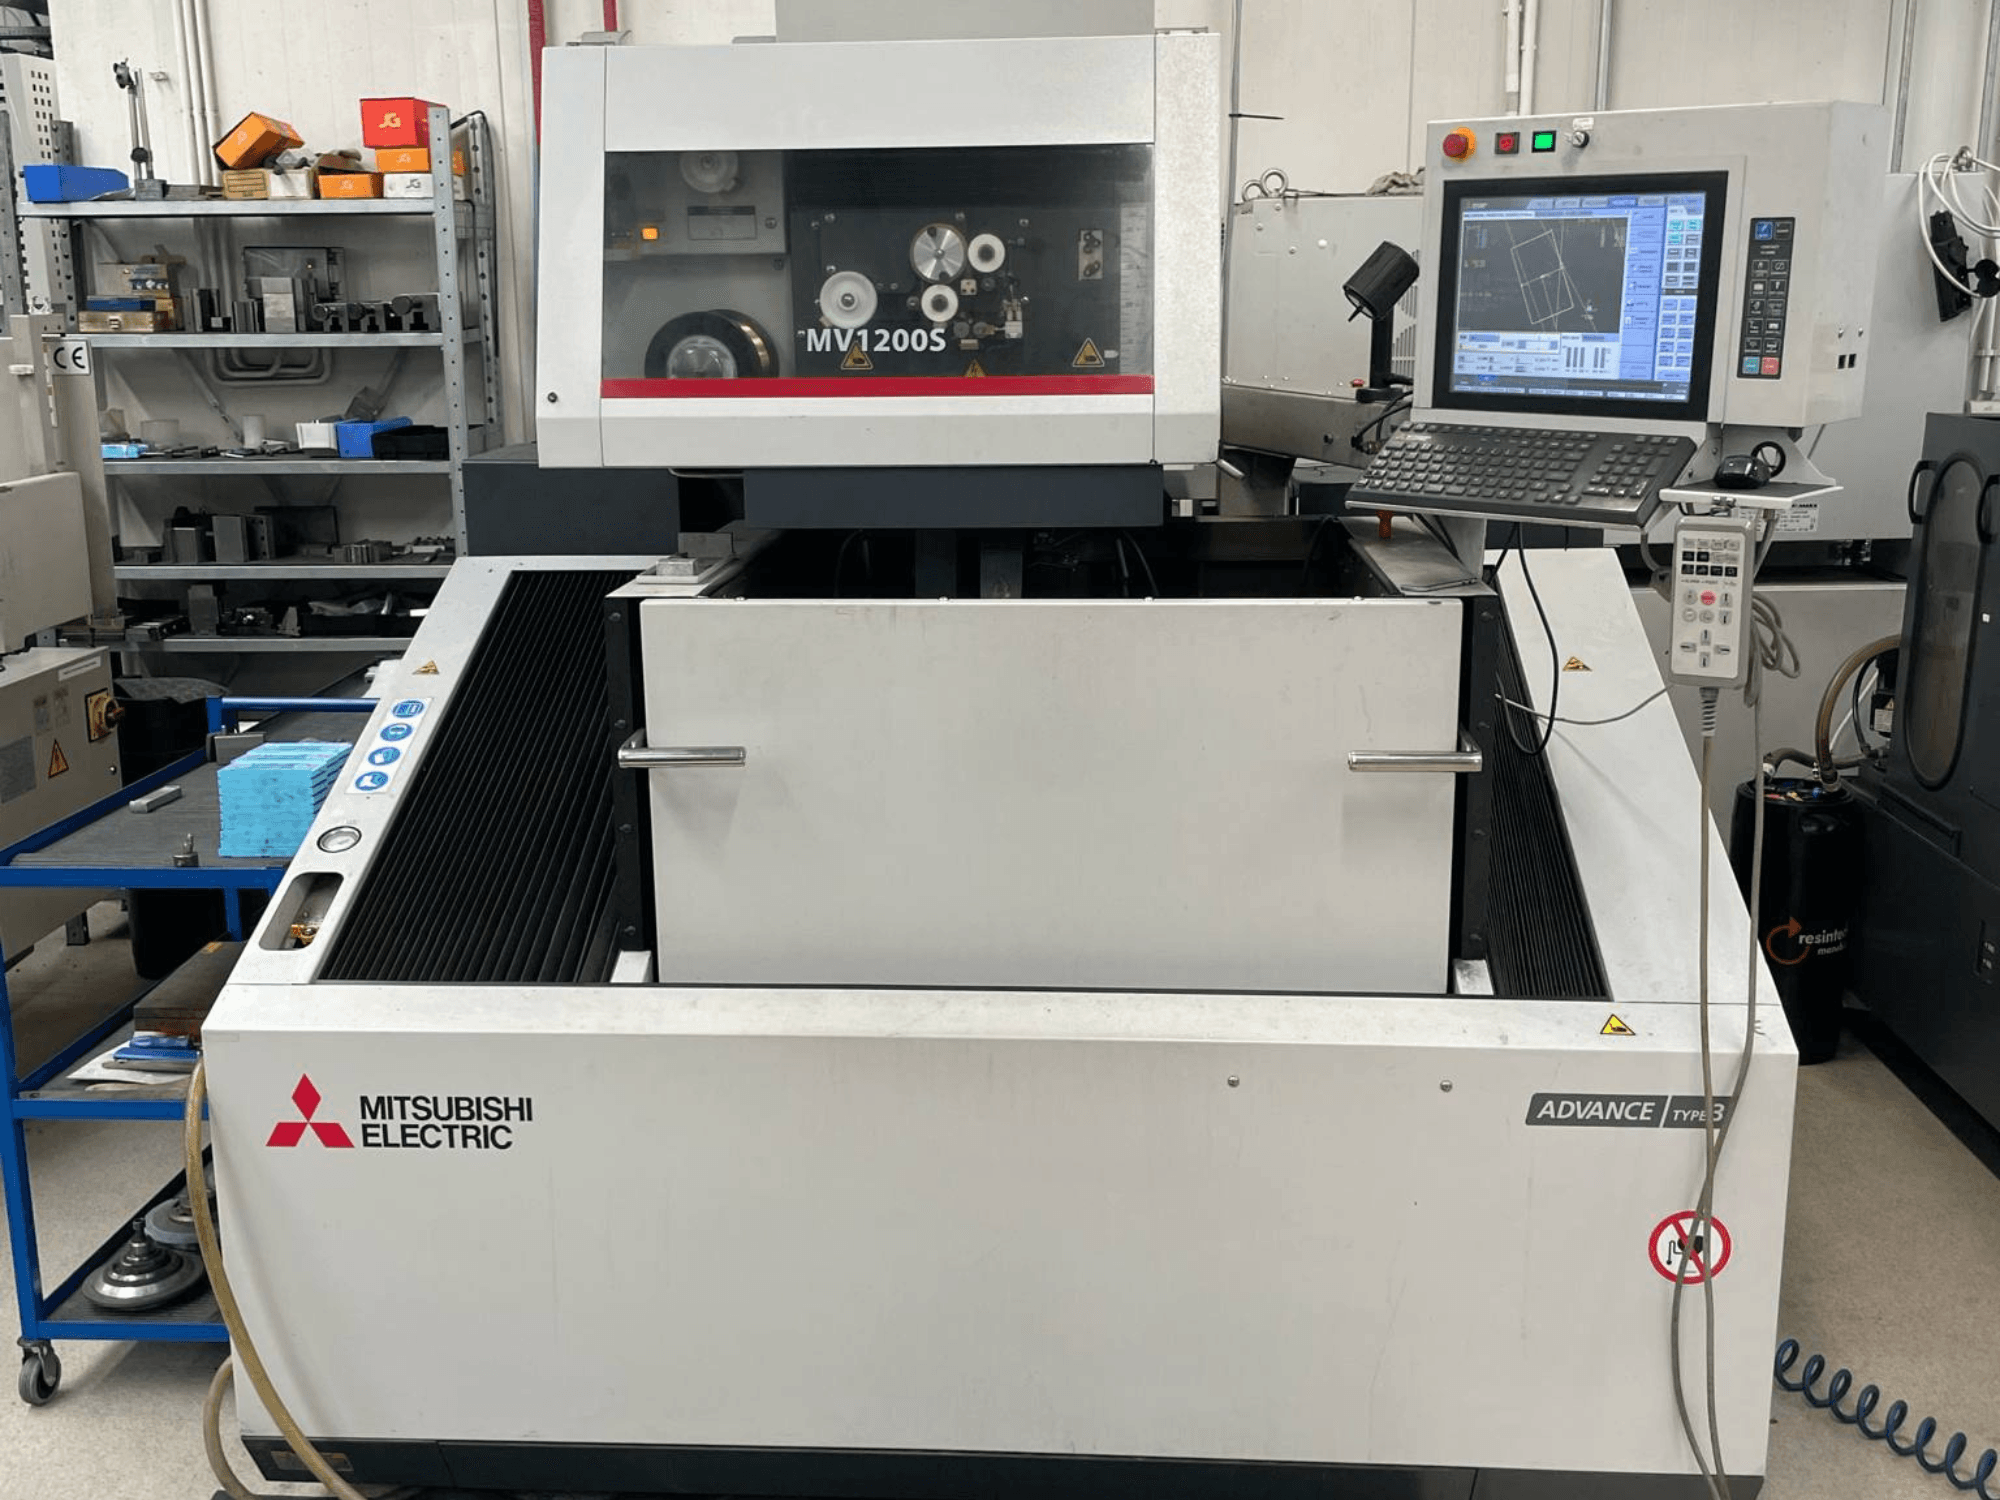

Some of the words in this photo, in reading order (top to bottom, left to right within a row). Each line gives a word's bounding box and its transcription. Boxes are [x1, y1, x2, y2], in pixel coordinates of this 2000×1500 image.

[806, 328, 946, 352] MV1200S
[53, 346, 86, 369] CE
[360, 1095, 533, 1121] MITSUBISHI
[1537, 1100, 1655, 1121] ADVANCE
[361, 1123, 513, 1150] ELECTRIC
